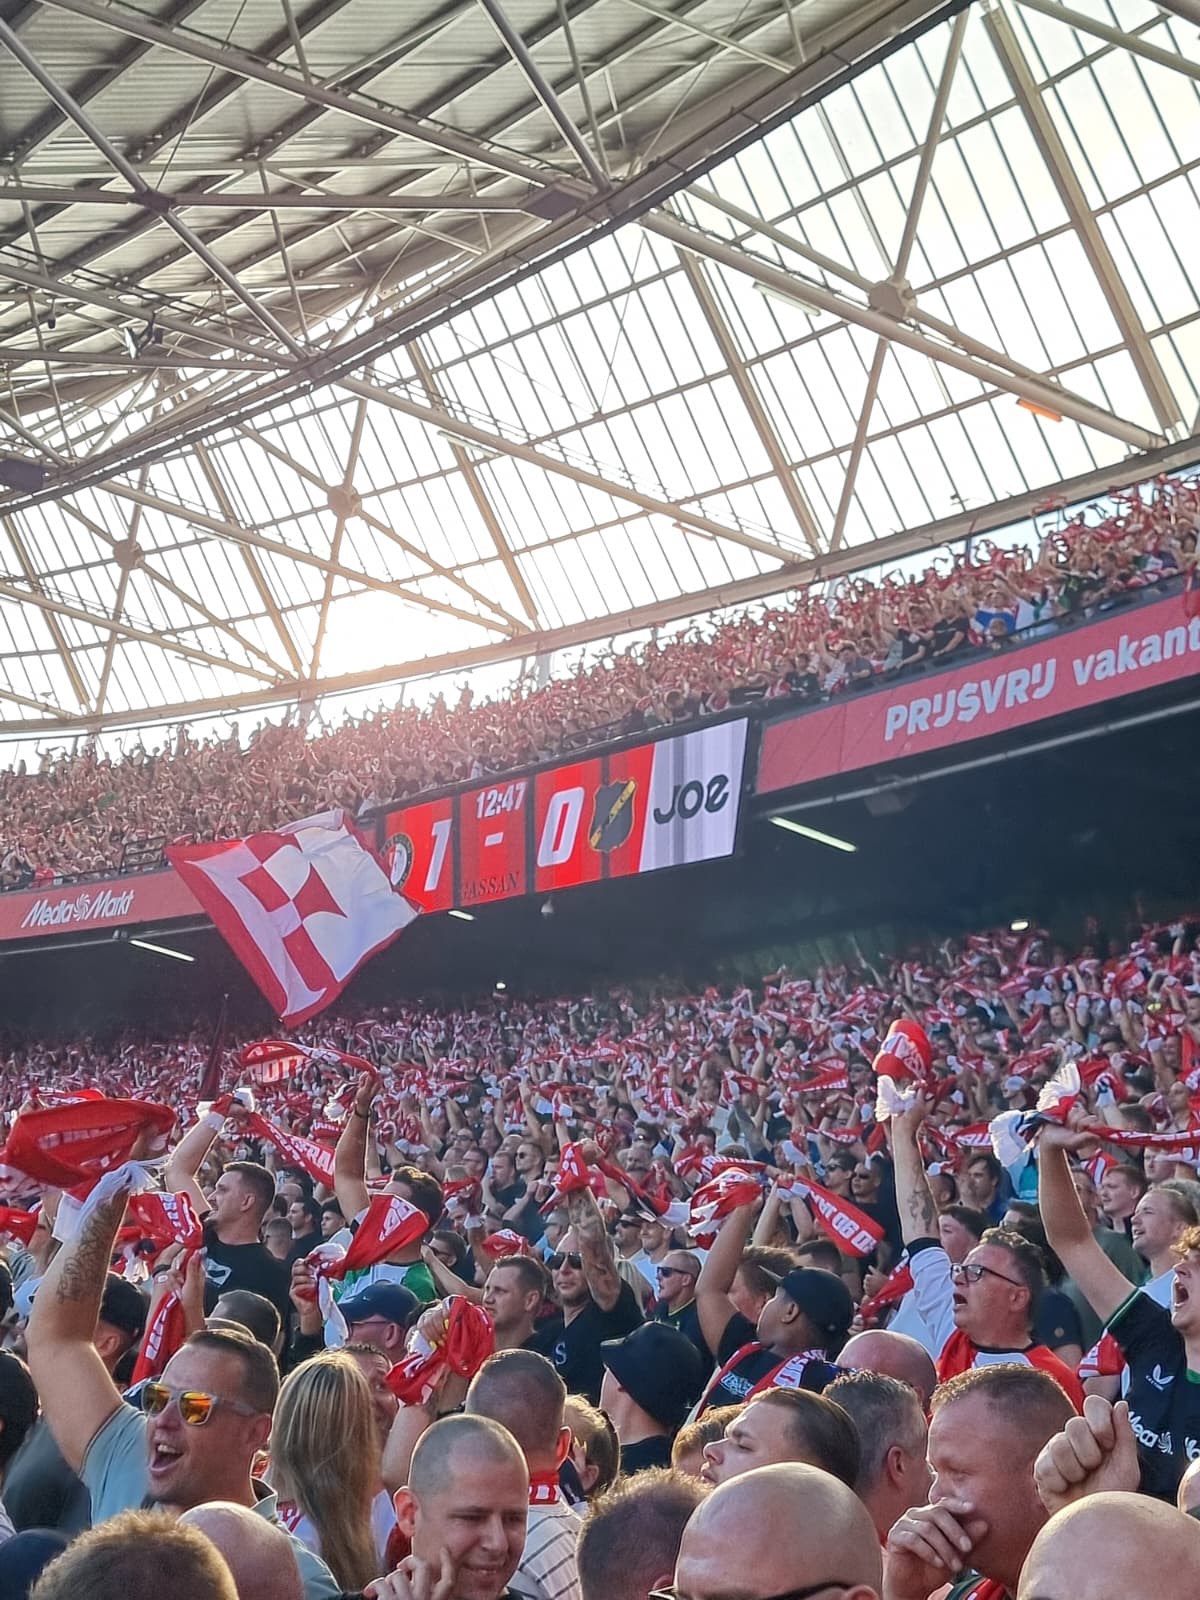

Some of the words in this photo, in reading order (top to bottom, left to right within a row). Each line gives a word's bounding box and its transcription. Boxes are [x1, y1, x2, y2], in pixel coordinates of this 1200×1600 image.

[1072, 616, 1200, 685] vakant
[476, 782, 525, 819] 12:47
[423, 818, 453, 892] 1
[536, 786, 586, 868] 0
[21, 899, 74, 929] Media
[85, 889, 135, 921] Markt
